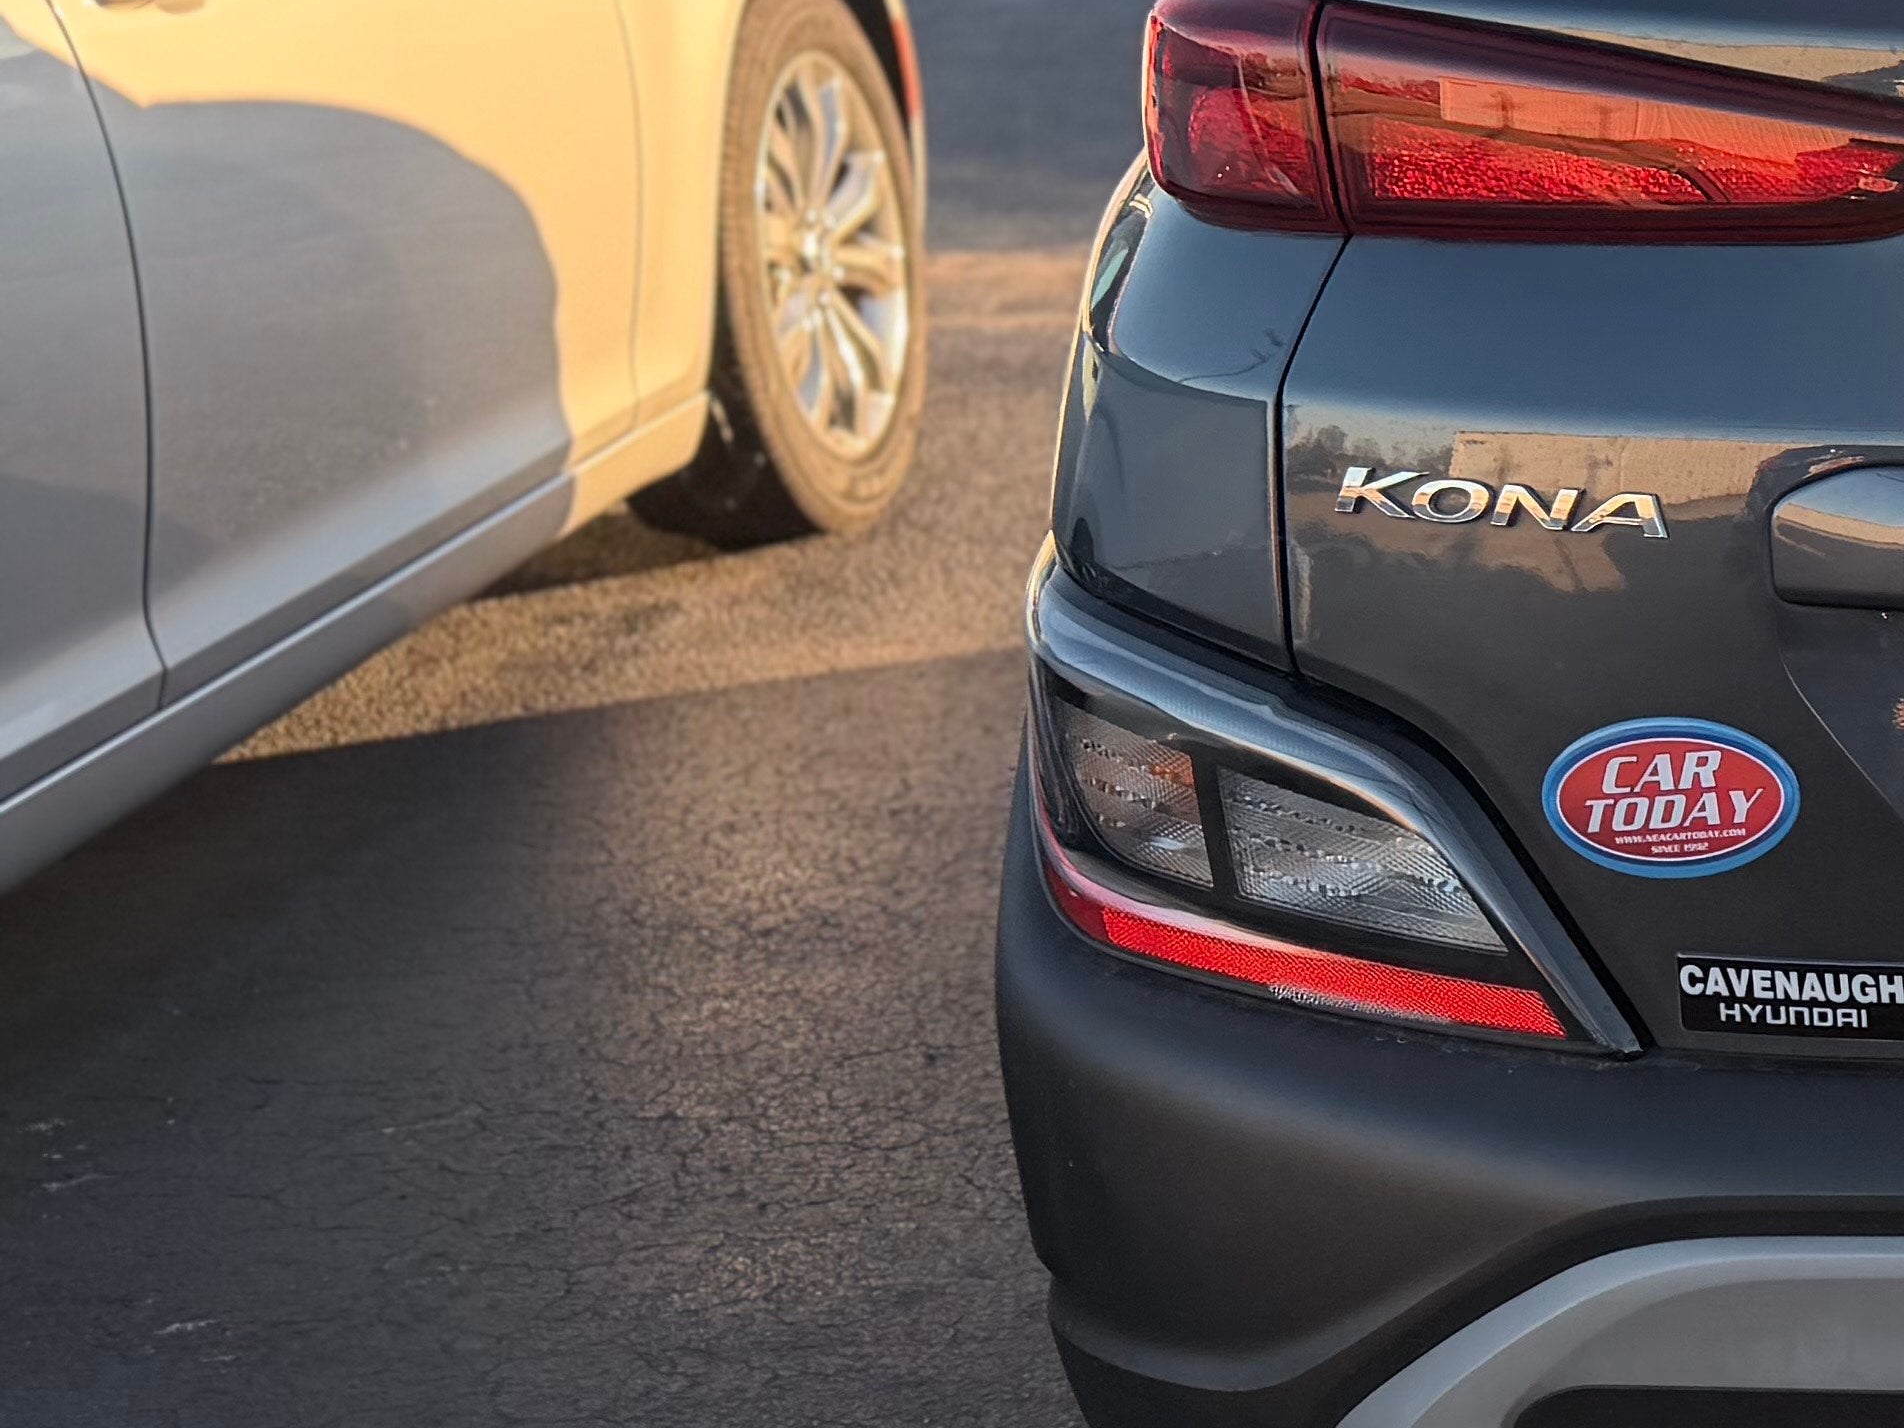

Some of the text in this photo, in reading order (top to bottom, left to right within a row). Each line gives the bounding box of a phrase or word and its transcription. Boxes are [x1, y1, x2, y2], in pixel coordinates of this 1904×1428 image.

[1335, 466, 1670, 539] KONA
[1602, 750, 1722, 794] CAR
[1585, 788, 1763, 833] TODAY
[1679, 965, 1904, 1003] CAVENAUGH
[1719, 1003, 1868, 1028] HYUNDAI
